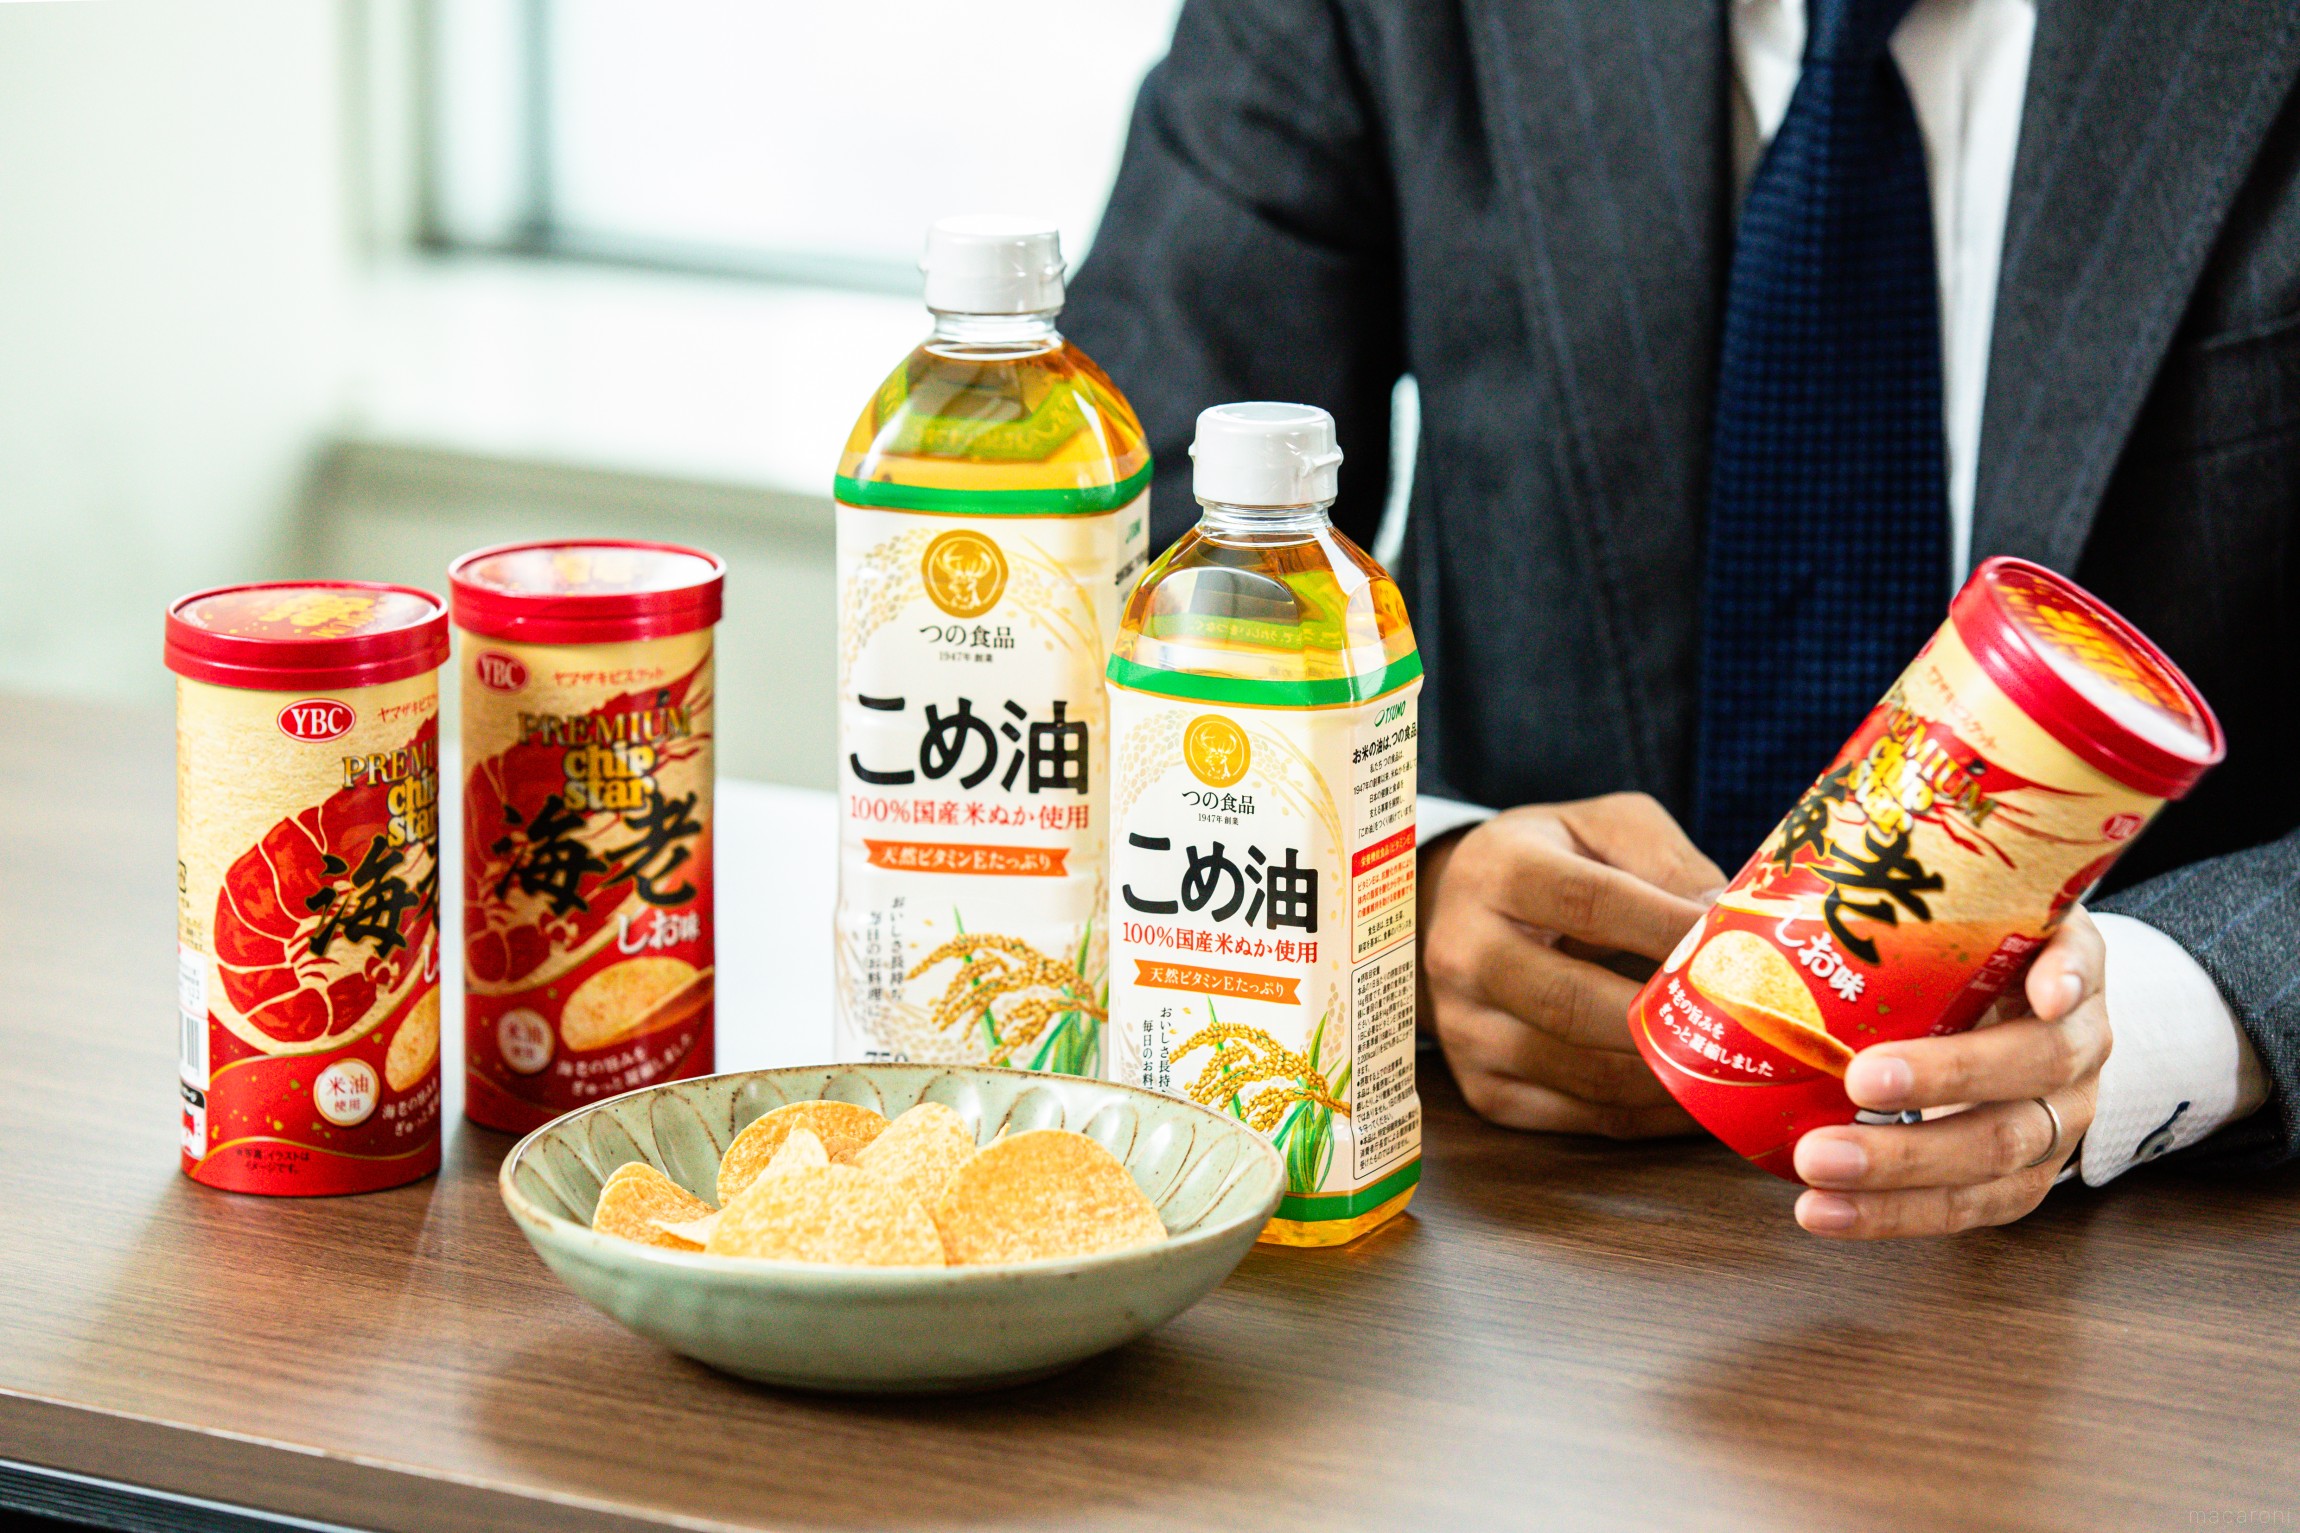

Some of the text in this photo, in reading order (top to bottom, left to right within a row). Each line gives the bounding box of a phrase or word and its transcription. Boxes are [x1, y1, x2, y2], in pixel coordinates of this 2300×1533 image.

[920, 625, 1014, 648] つの食品
[481, 656, 520, 689] YBC
[291, 708, 344, 736] YBC
[517, 705, 692, 746] PREMIUM
[563, 740, 657, 780] chip
[850, 694, 1089, 795] こめ油
[563, 775, 658, 812] star
[1182, 791, 1255, 815] つの食品
[850, 795, 1089, 830] 100%国産米ぬか使用
[1198, 813, 1223, 824] 1947年
[491, 791, 703, 916] 海老
[880, 846, 1051, 872] 天然ビタミンEたっぷり
[1122, 832, 1319, 934] こめ油
[618, 908, 701, 954] しお味
[1122, 921, 1319, 964] 100%国産米ぬか使用
[1775, 904, 1866, 1002] しお味
[1150, 966, 1285, 997] 天然ビタミンEたっぷり
[1142, 1020, 1154, 1089] 毎日のお料
[1159, 1007, 1173, 1092] おいしさ長持
[327, 1073, 370, 1096] 米油
[334, 1099, 361, 1112] 使用
